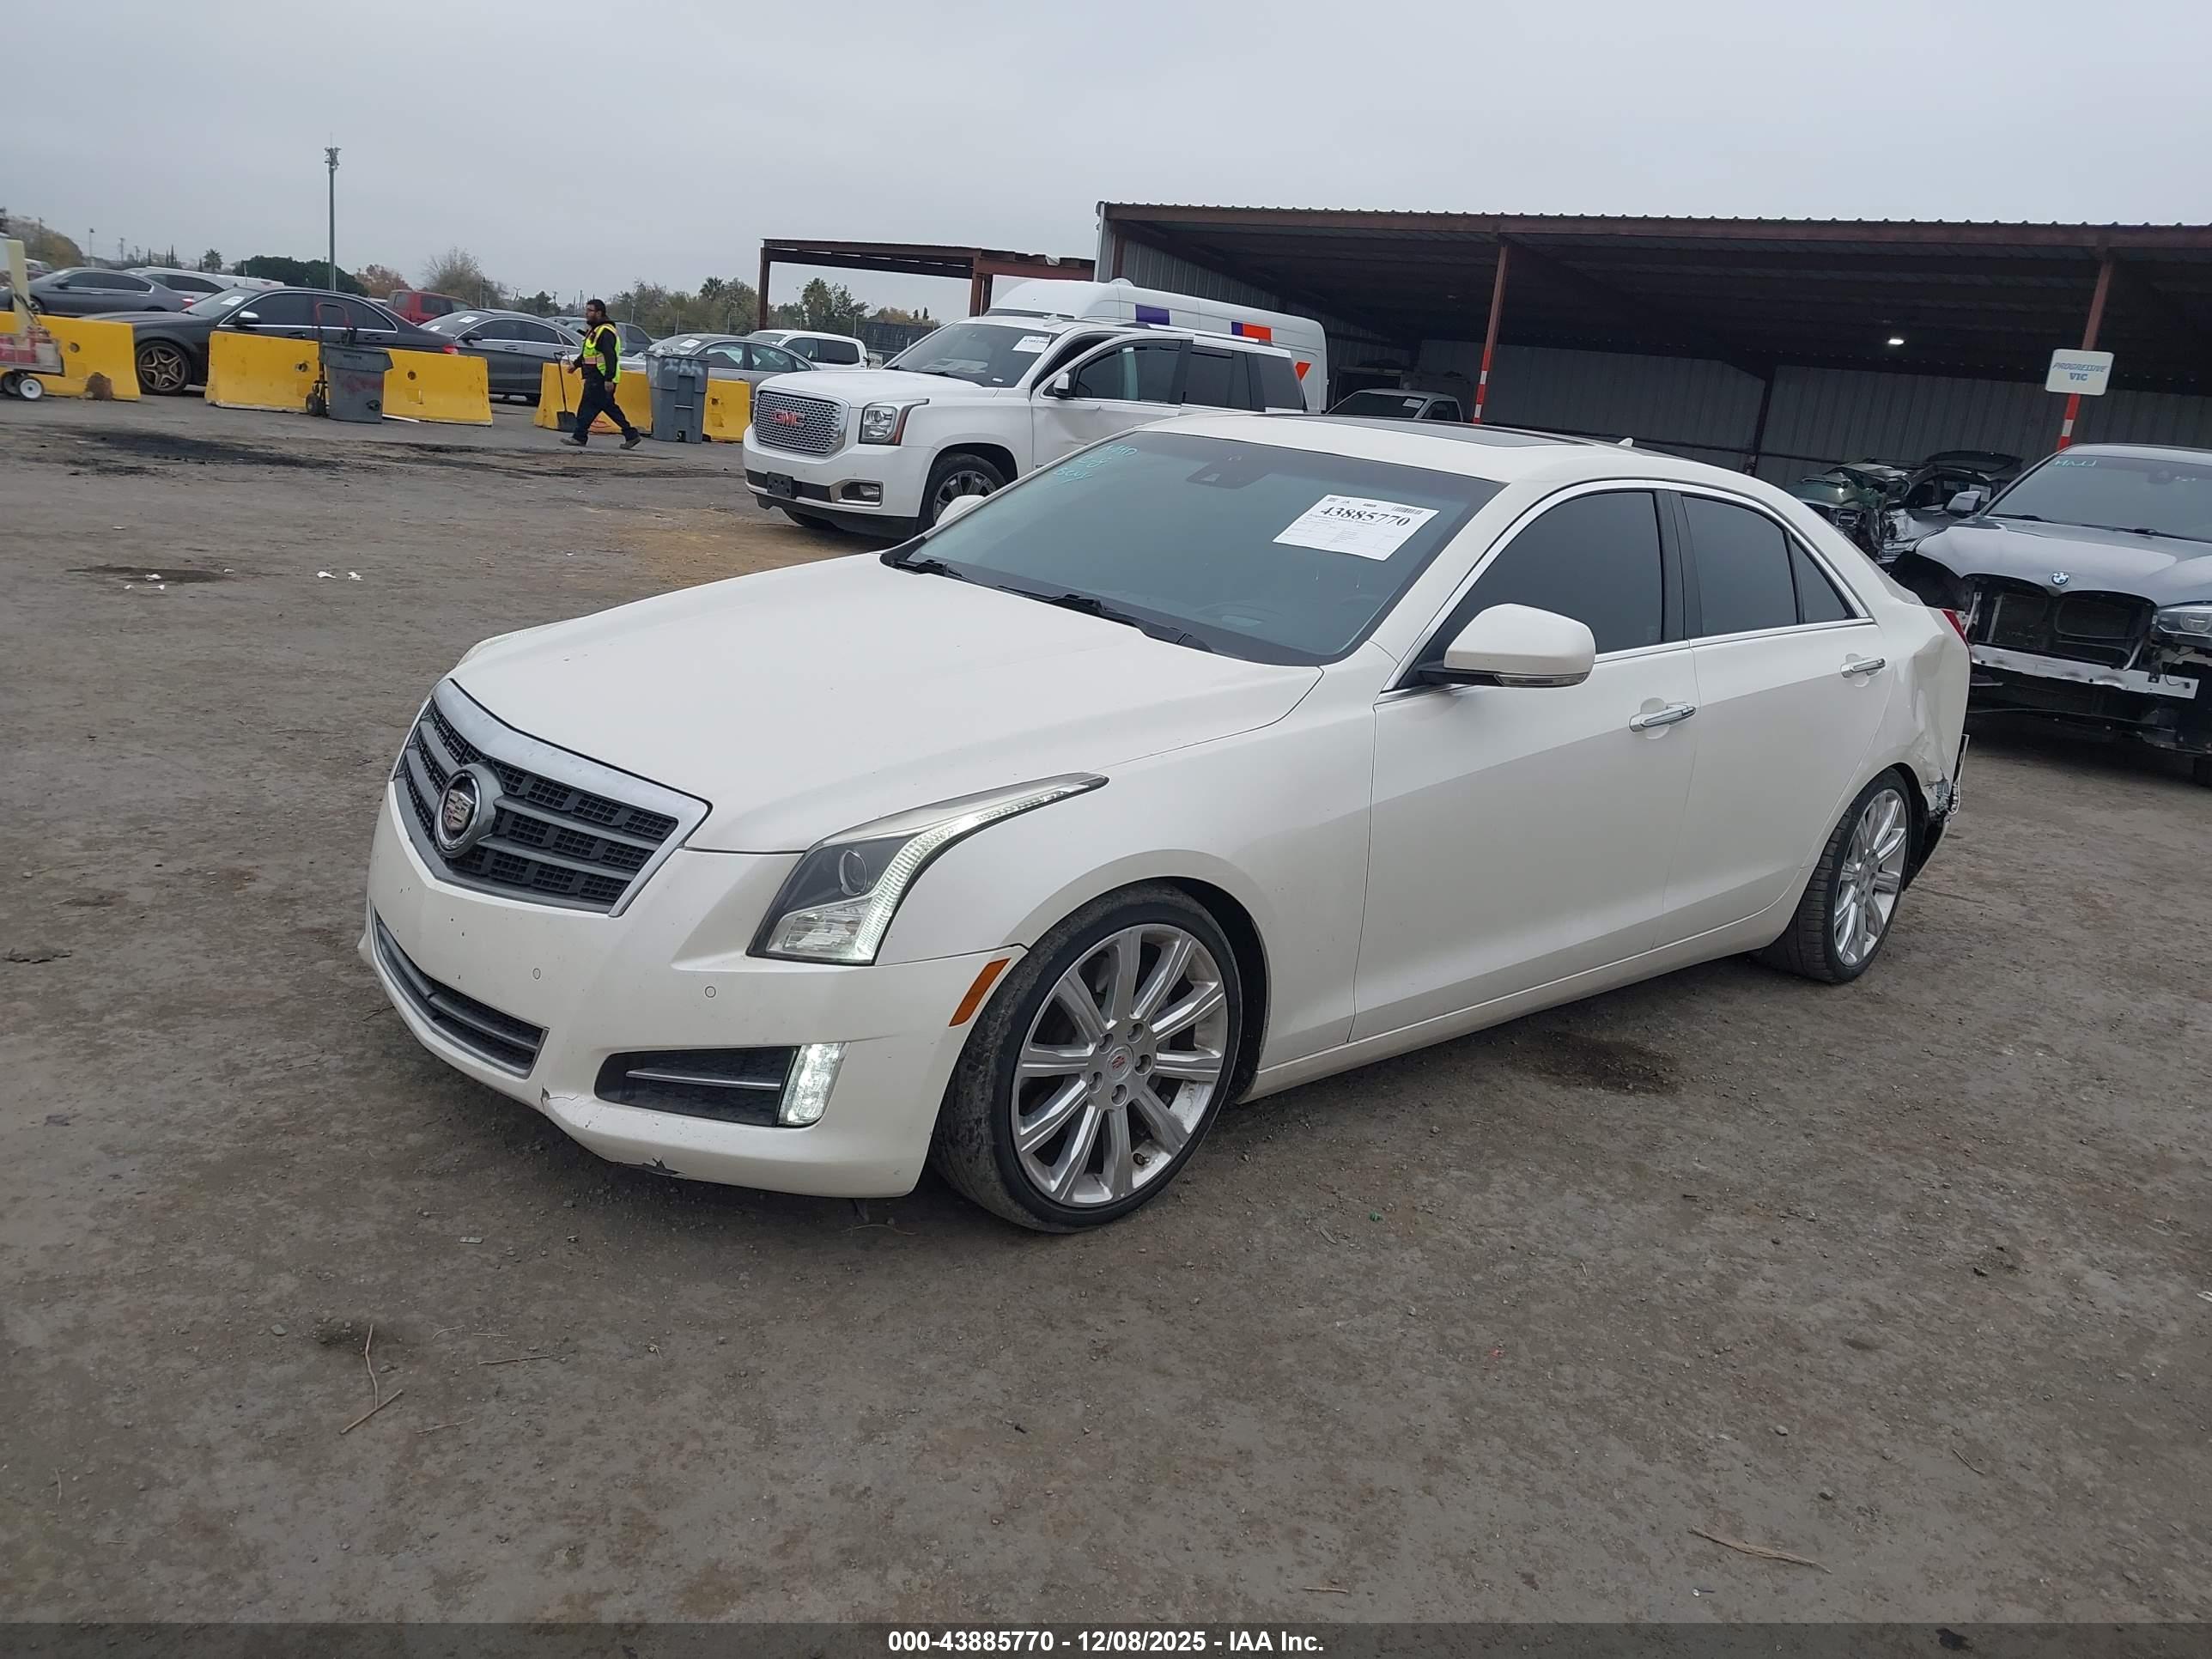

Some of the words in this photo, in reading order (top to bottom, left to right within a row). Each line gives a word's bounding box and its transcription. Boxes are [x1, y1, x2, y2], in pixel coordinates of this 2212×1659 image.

[2069, 372, 2088, 381] VIC
[773, 410, 805, 428] GMC
[1321, 506, 1411, 527] 43885770
